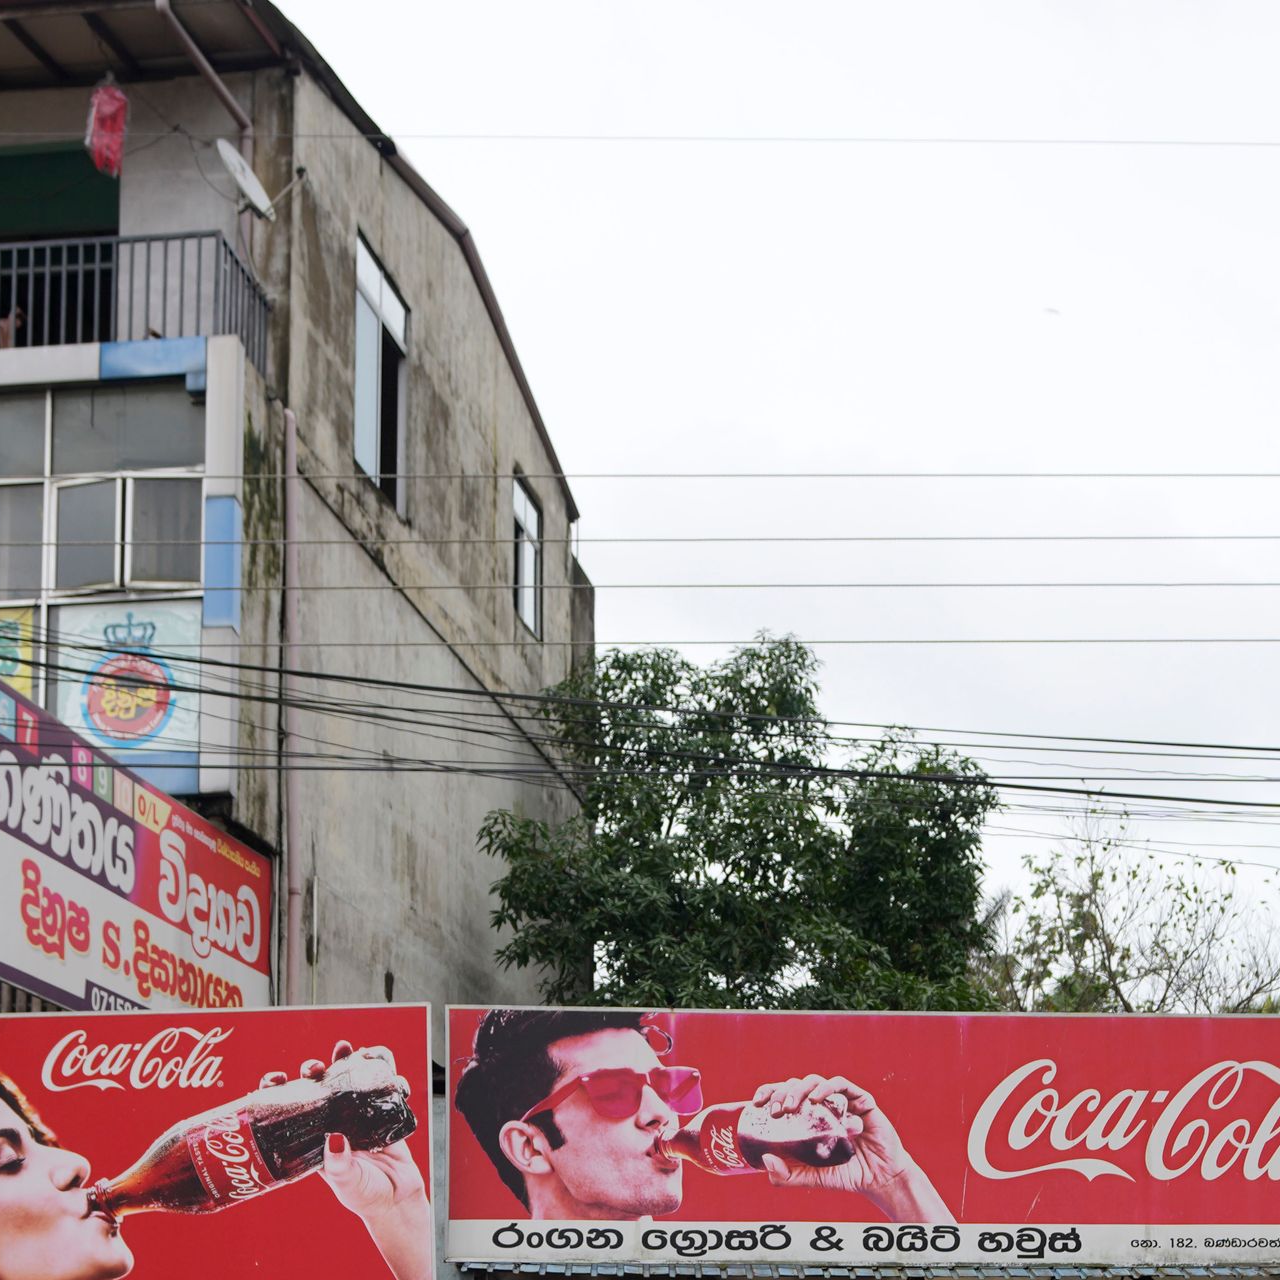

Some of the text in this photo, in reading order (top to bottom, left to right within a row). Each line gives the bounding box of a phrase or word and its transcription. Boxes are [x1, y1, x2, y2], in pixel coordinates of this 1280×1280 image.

[22, 712, 34, 745] 7
[77, 750, 88, 783] 8
[98, 765, 108, 796] 9
[158, 829, 261, 963] විද්‍යාව
[41, 1026, 235, 1092] Coca-Cola
[492, 1222, 624, 1250] රංගන
[809, 1226, 845, 1251] &
